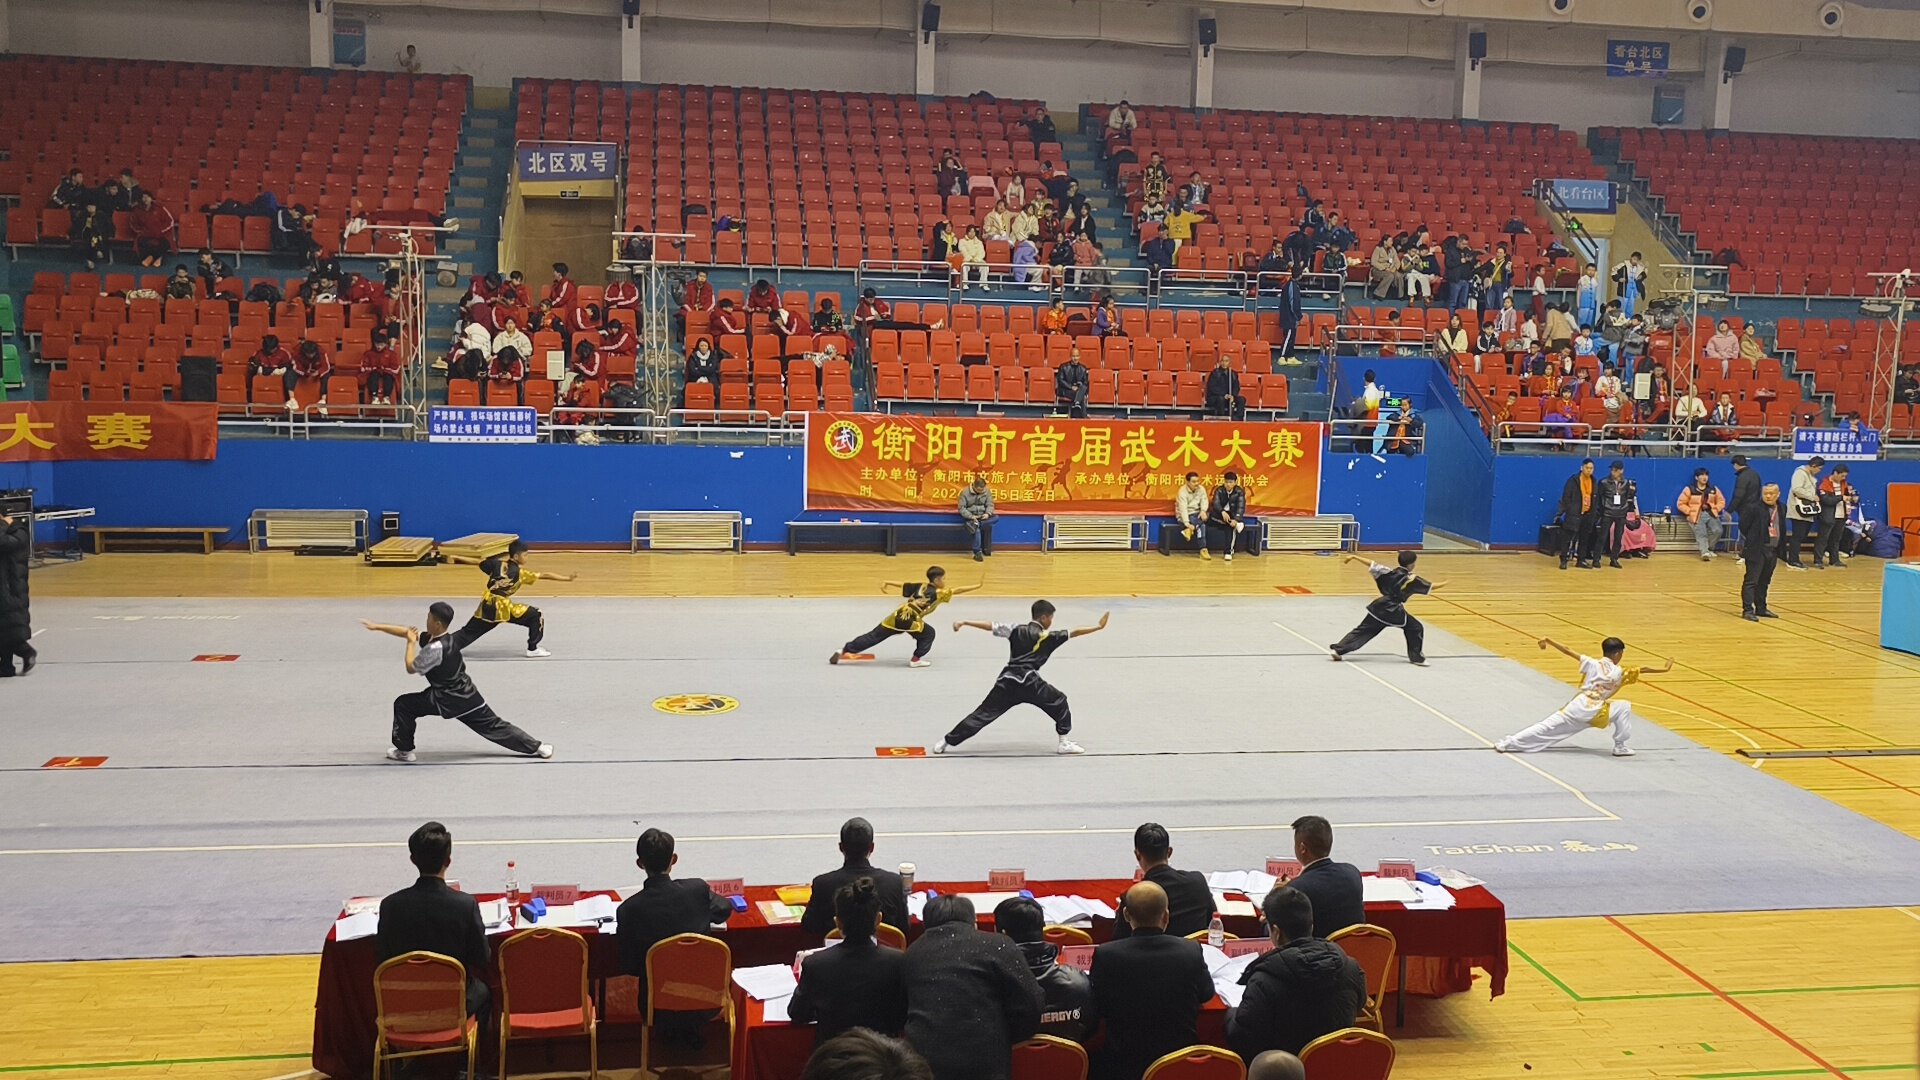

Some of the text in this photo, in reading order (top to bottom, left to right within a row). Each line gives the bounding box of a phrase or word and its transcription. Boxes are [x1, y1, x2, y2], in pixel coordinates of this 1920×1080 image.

[1614, 45, 1663, 59] 看台北区
[528, 151, 608, 174] 北区双号
[0, 412, 153, 450] 大赛
[871, 421, 1304, 469] 衡阳市首届武术大赛
[1074, 471, 1269, 487] 承办单位：衡阳市术运协会
[859, 485, 873, 498] 时
[1423, 843, 1554, 855] TaiShan
